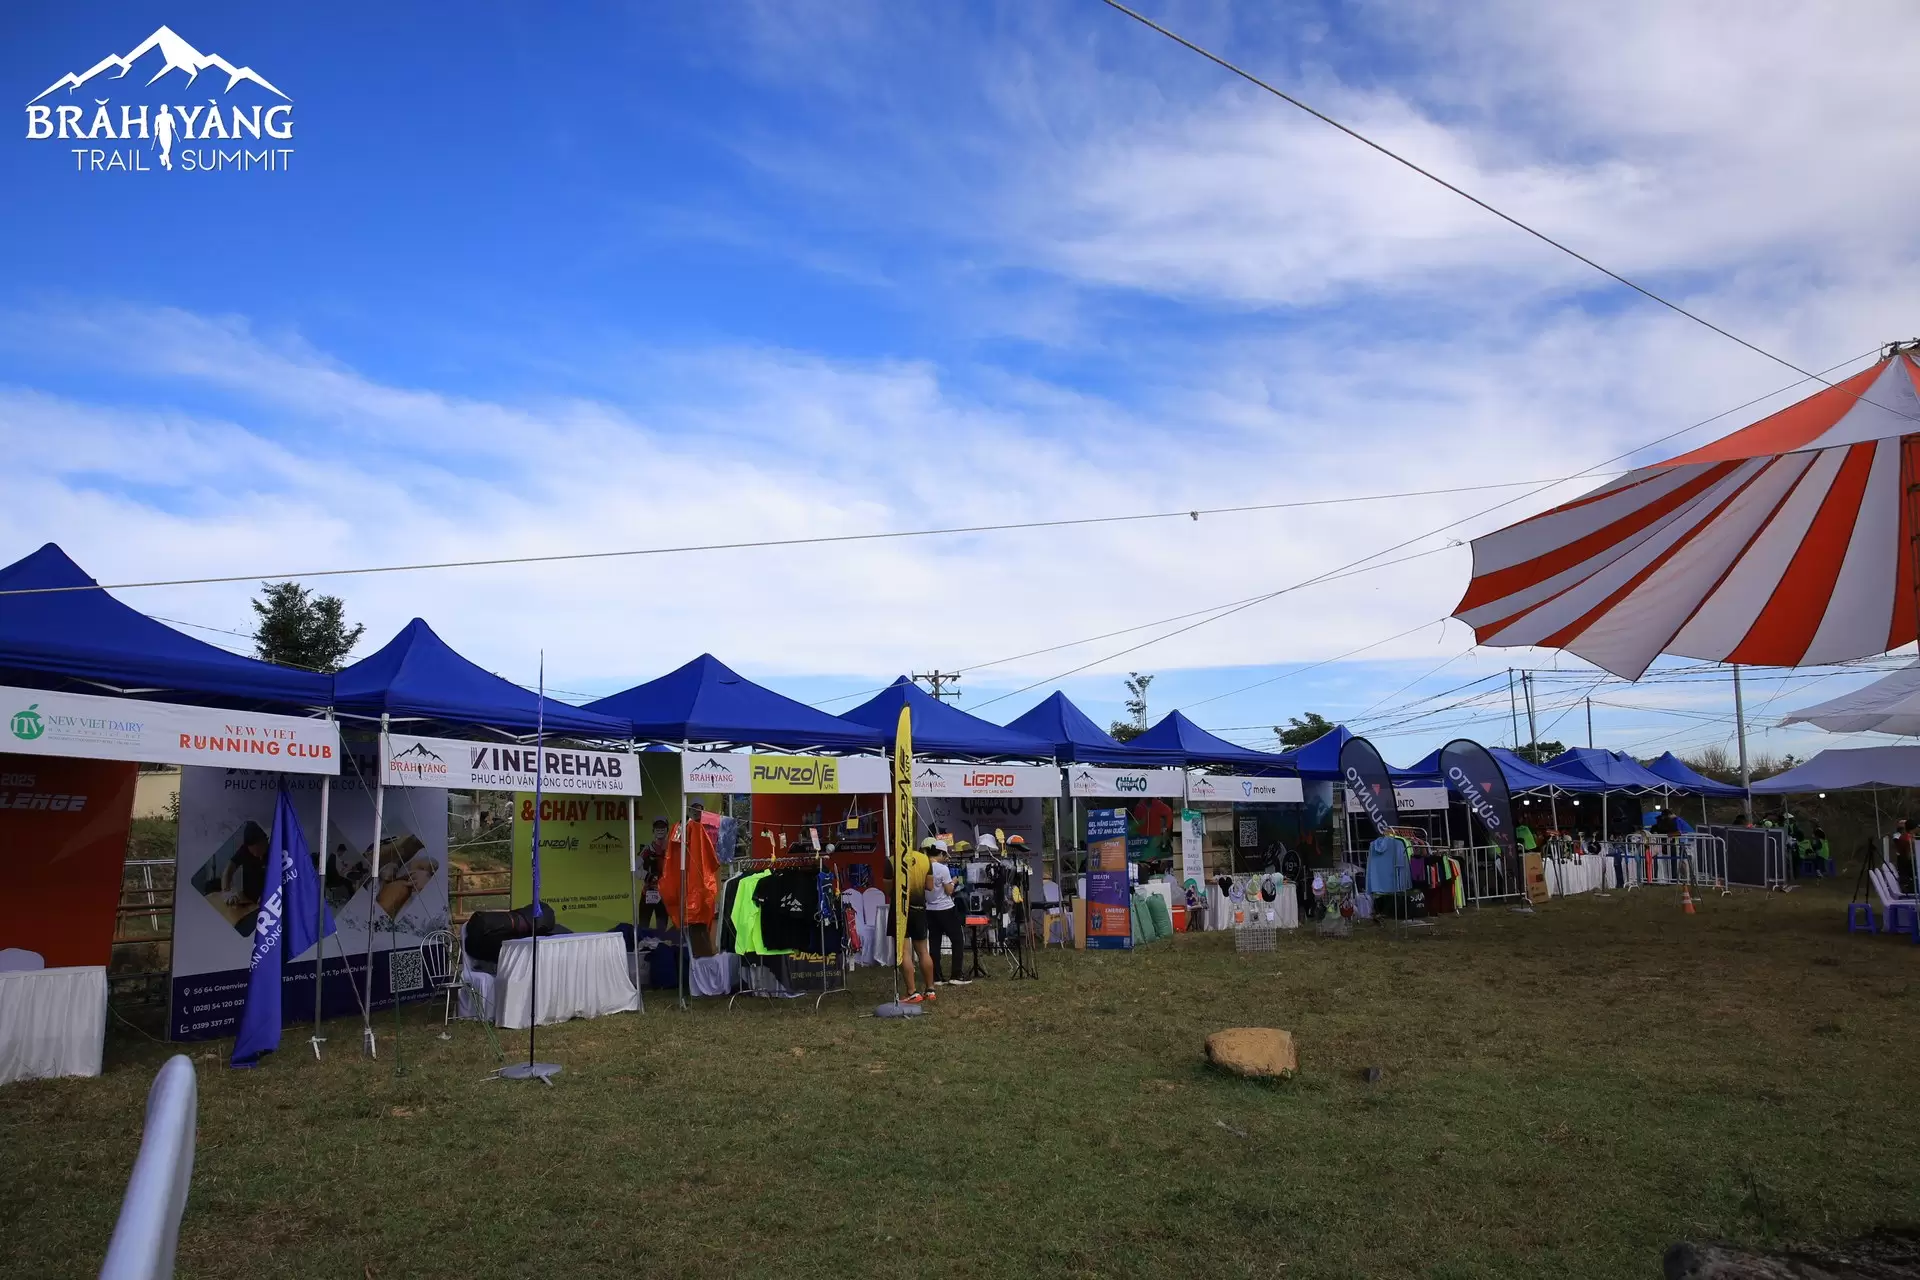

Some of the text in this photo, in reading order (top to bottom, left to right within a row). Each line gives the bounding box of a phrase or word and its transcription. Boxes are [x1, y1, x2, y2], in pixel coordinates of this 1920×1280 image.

[48, 715, 144, 733] NEW VIET DAIRY
[225, 724, 297, 740] NEW VIET
[179, 733, 332, 758] RUNNING CLUB
[545, 752, 622, 778] REHAB
[1, 773, 37, 788] 2025
[753, 760, 834, 790] RUNZONE
[1253, 785, 1276, 795] motive
[521, 800, 535, 820] &
[594, 801, 643, 821] TRAL
[193, 1004, 211, 1013] (028)
[192, 1021, 210, 1030] 0399
